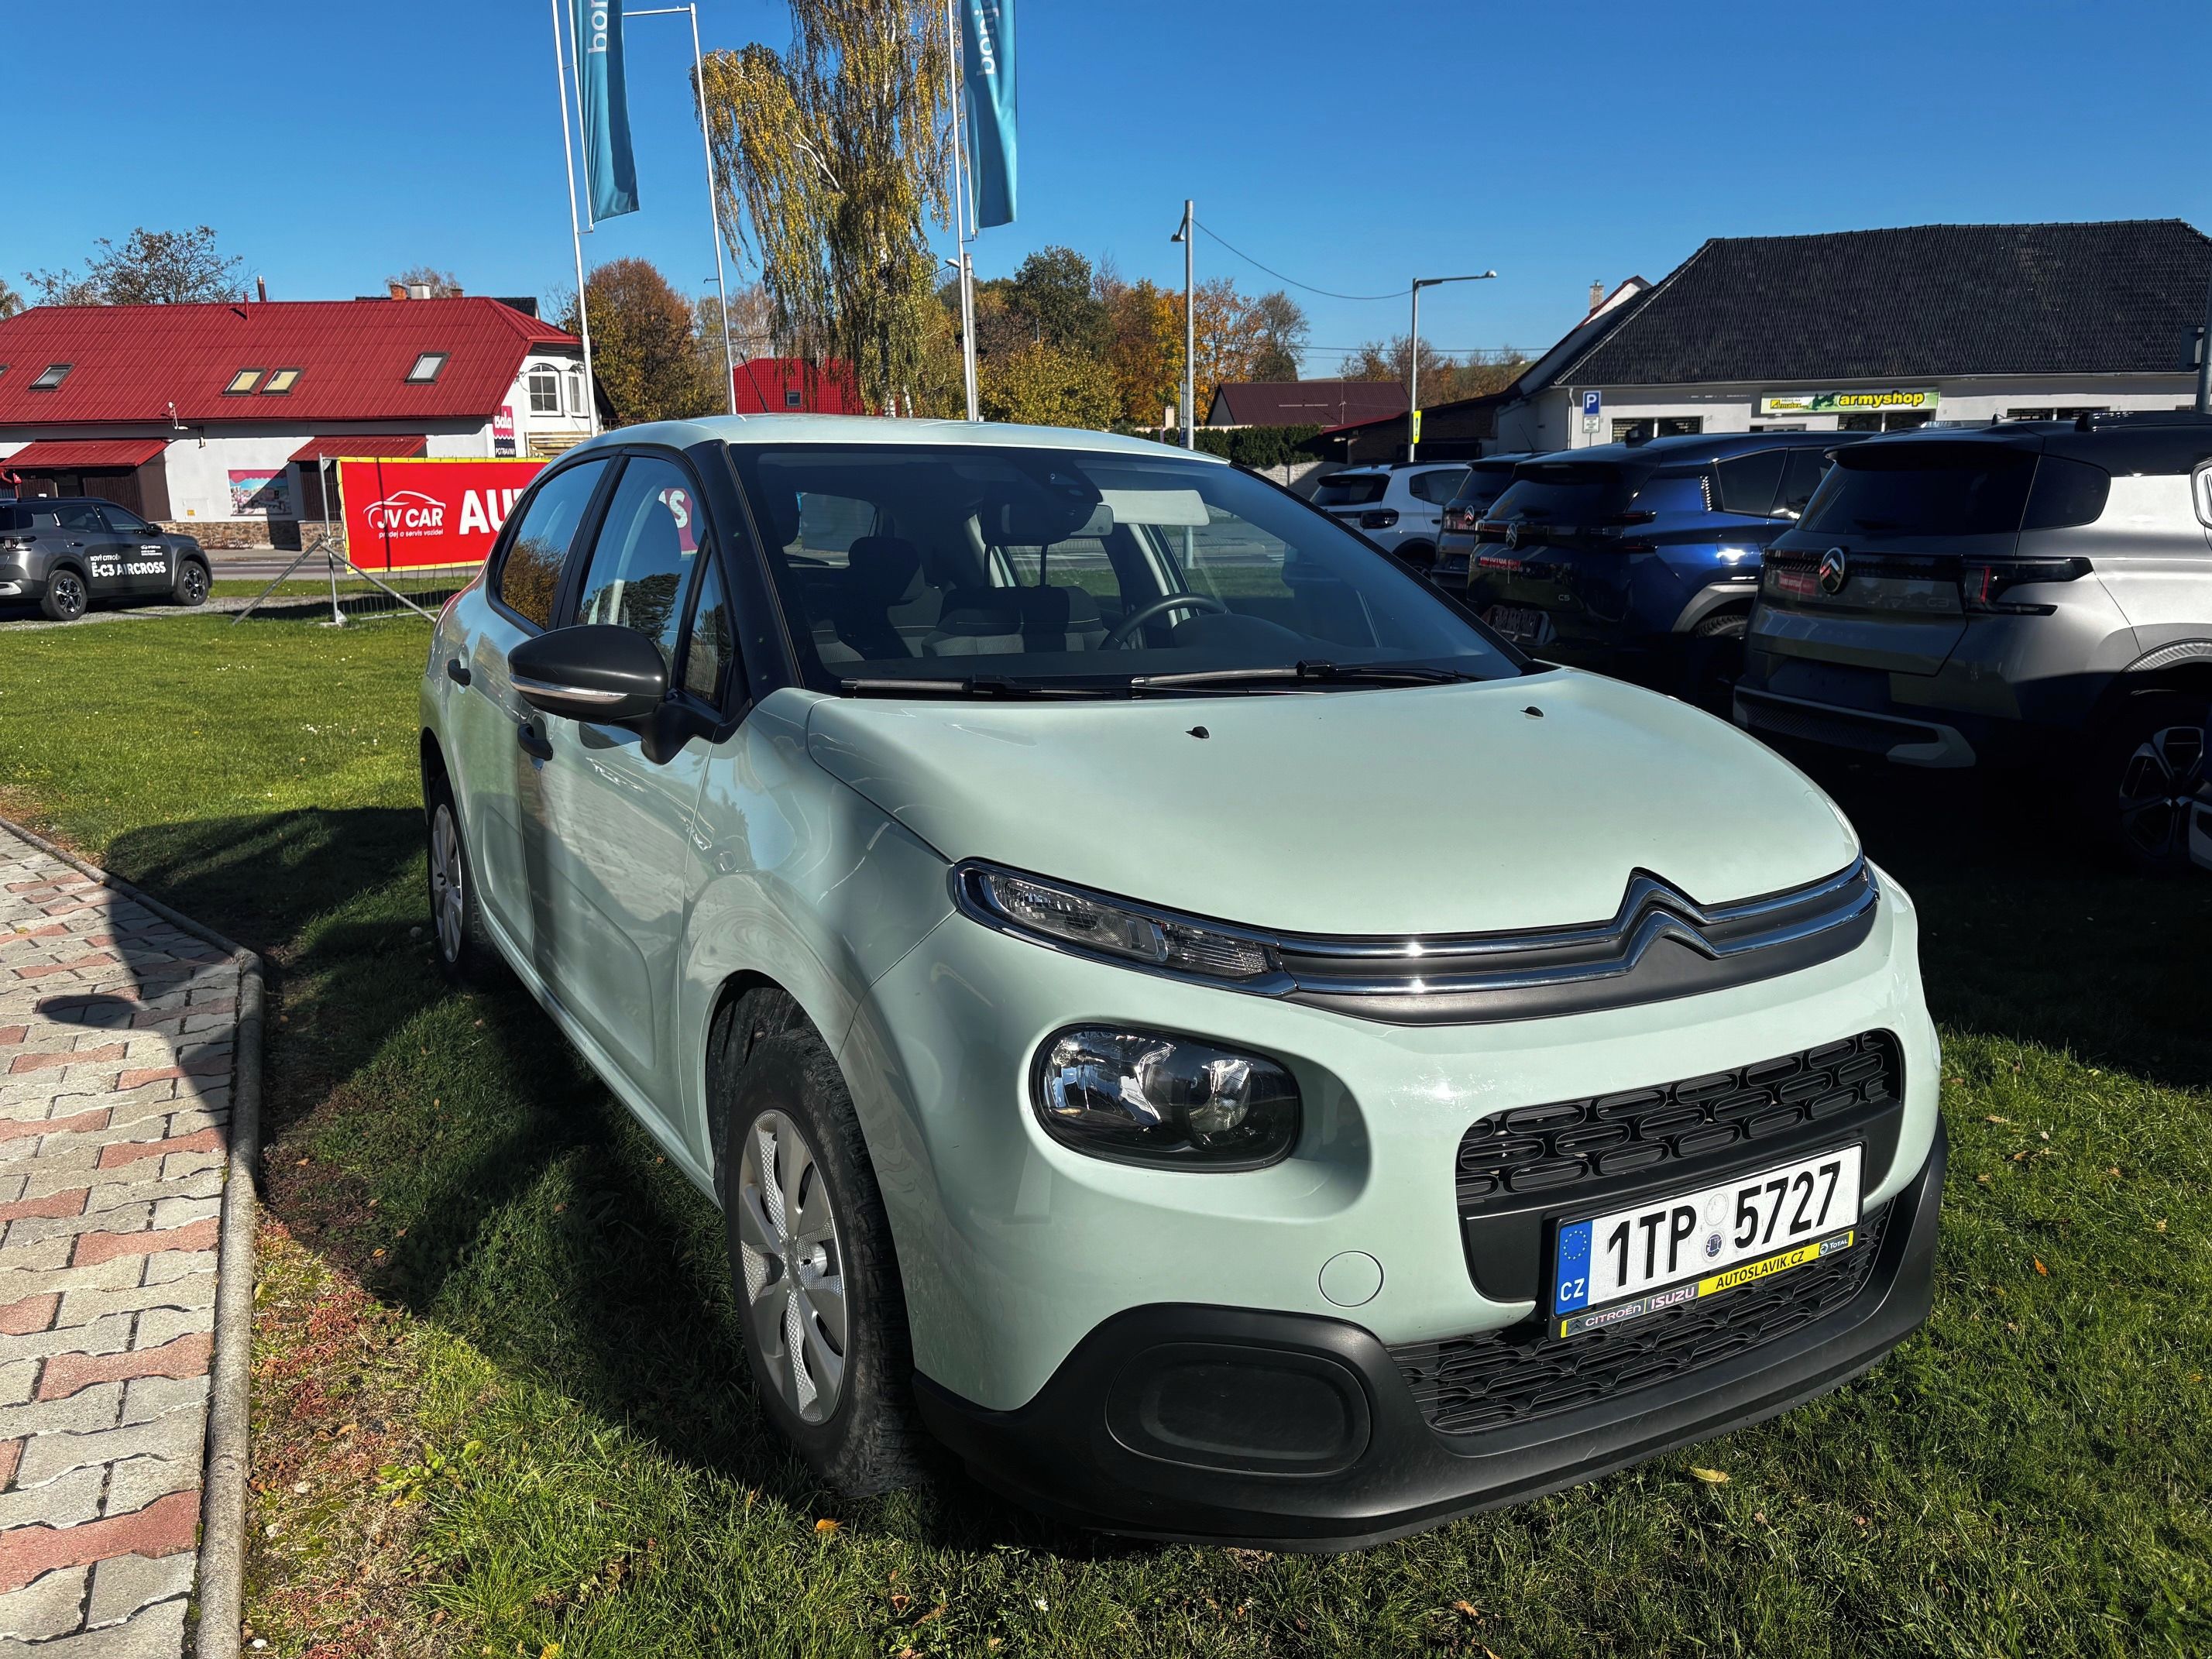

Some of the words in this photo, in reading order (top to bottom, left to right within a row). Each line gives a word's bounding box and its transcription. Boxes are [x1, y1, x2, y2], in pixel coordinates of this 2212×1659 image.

[974, 0, 999, 76] bonj
[1586, 393, 1597, 409] P
[1839, 391, 1924, 407] armyshop
[376, 508, 402, 530] JV
[405, 507, 444, 528] CAR
[116, 561, 167, 576] AIRCROSS
[1607, 1205, 1696, 1287] 1TP
[1734, 1160, 1841, 1249] 5727
[1829, 1239, 1849, 1249] TOTAL
[1716, 1250, 1805, 1290] AUTOSLAVIK.CZ
[1560, 1279, 1585, 1301] CZ
[1650, 1286, 1695, 1310] ISUZU
